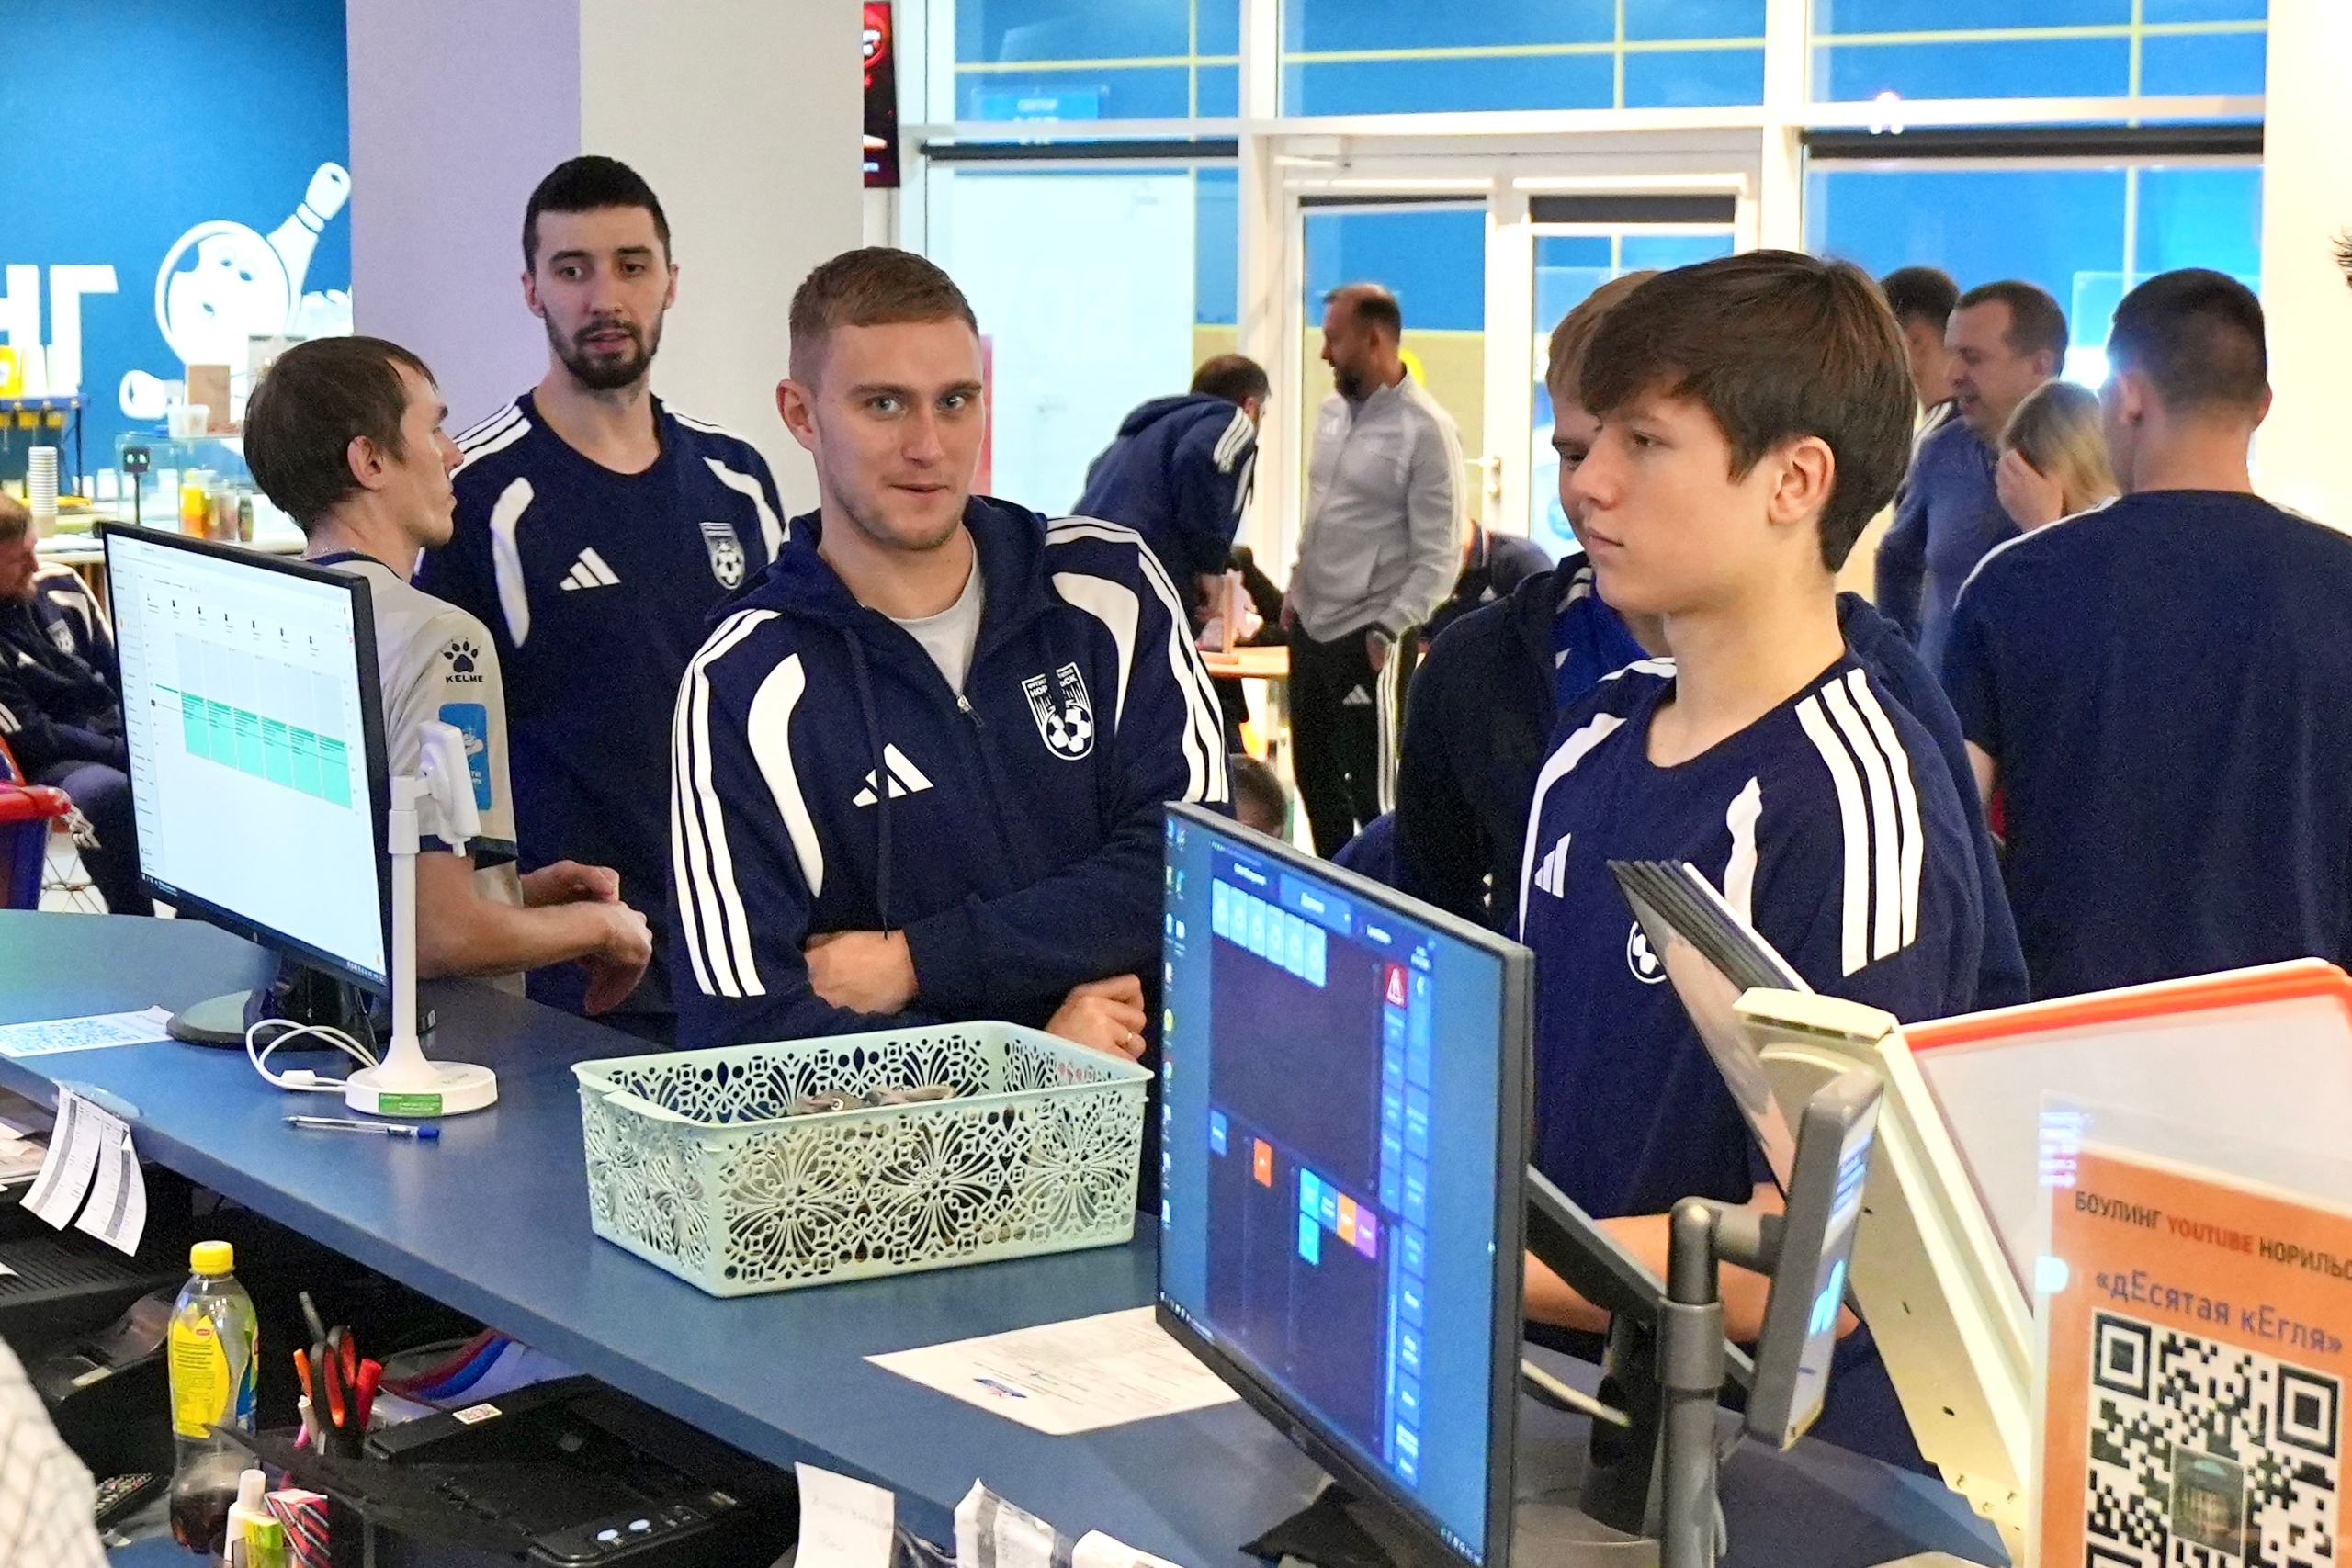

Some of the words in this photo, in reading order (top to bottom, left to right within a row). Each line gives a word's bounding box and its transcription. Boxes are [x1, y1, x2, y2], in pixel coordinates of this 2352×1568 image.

[446, 674, 484, 683] KELME
[2075, 1190, 2162, 1229] БОУЛИНГ
[2166, 1214, 2253, 1255] YOUTUBE
[2096, 1269, 2230, 1325] «дЕсятая
[2240, 1304, 2343, 1353] кЕгля»
